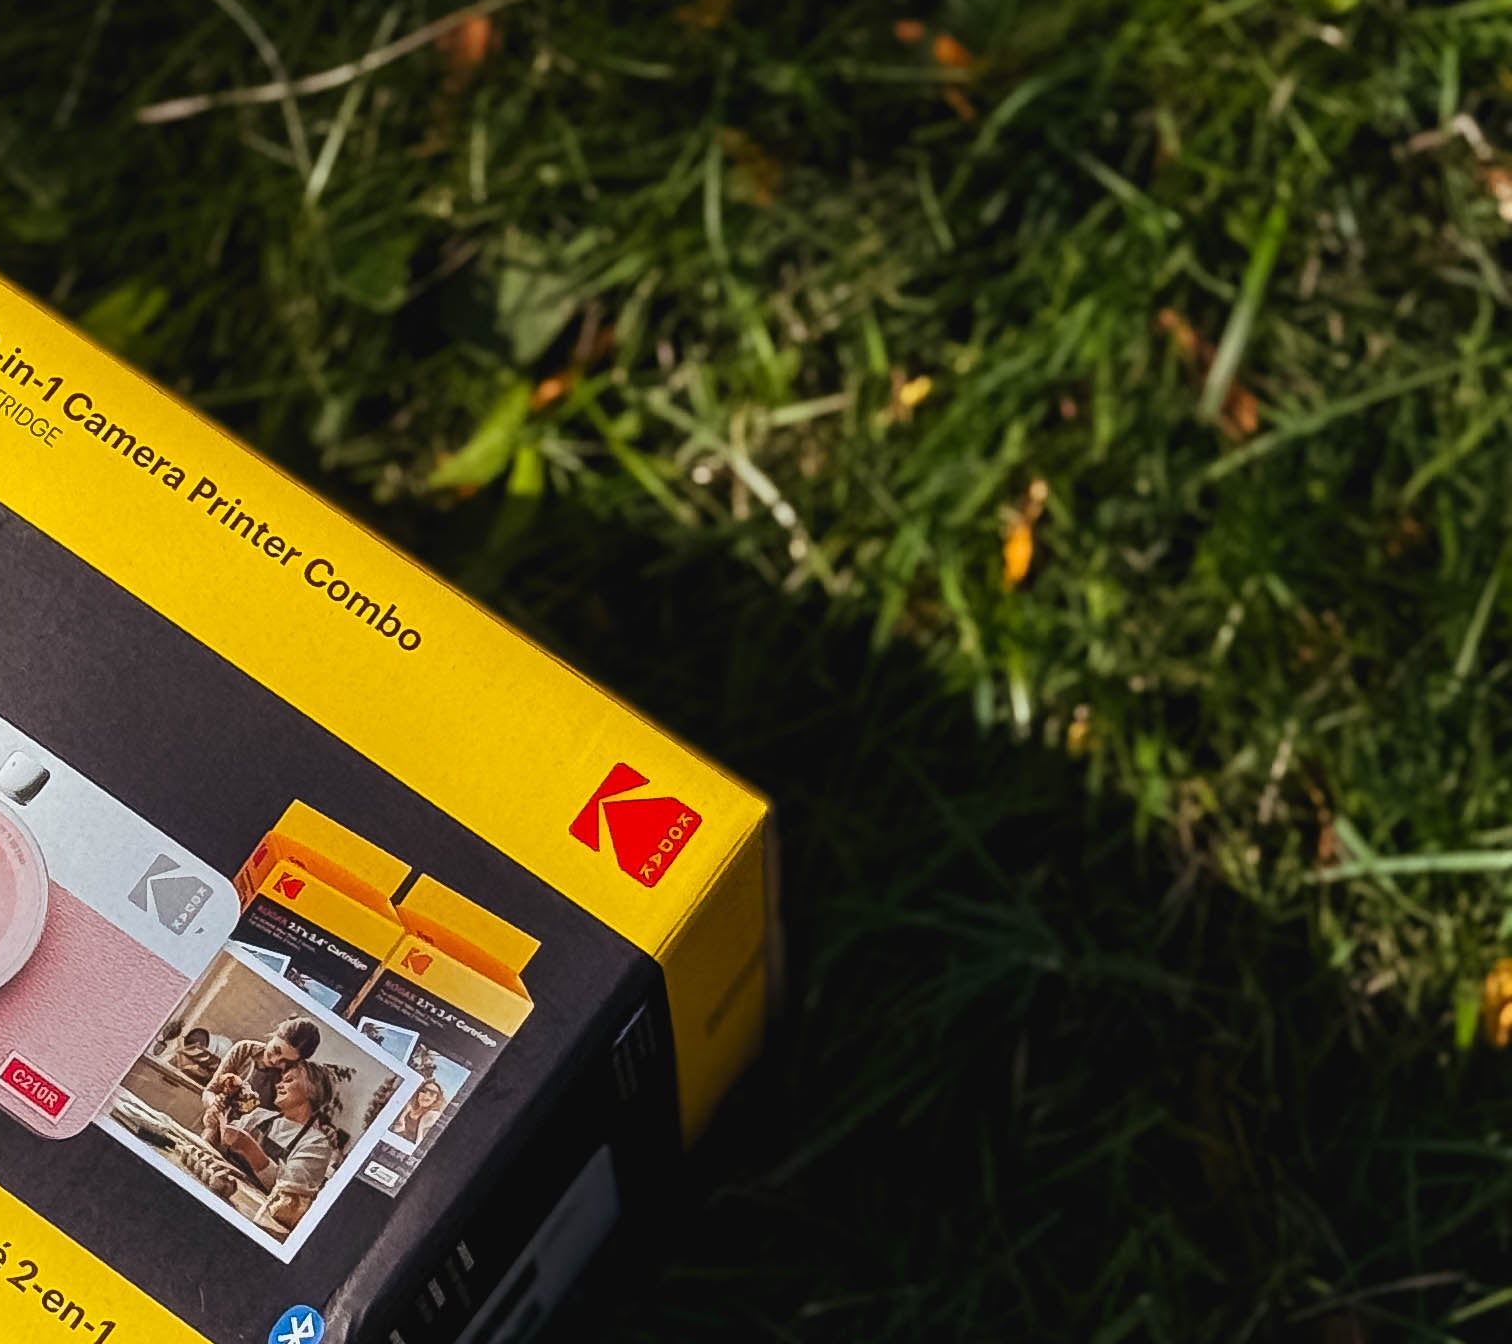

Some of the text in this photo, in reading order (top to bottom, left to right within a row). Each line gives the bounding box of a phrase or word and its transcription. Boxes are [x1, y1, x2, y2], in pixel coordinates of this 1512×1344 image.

[63, 392, 185, 489] Camera
[187, 477, 301, 565] Printer
[304, 558, 421, 650] Combo
[639, 812, 693, 879] KODAK
[171, 886, 207, 929] KODAK
[12, 1069, 58, 1108] C210R
